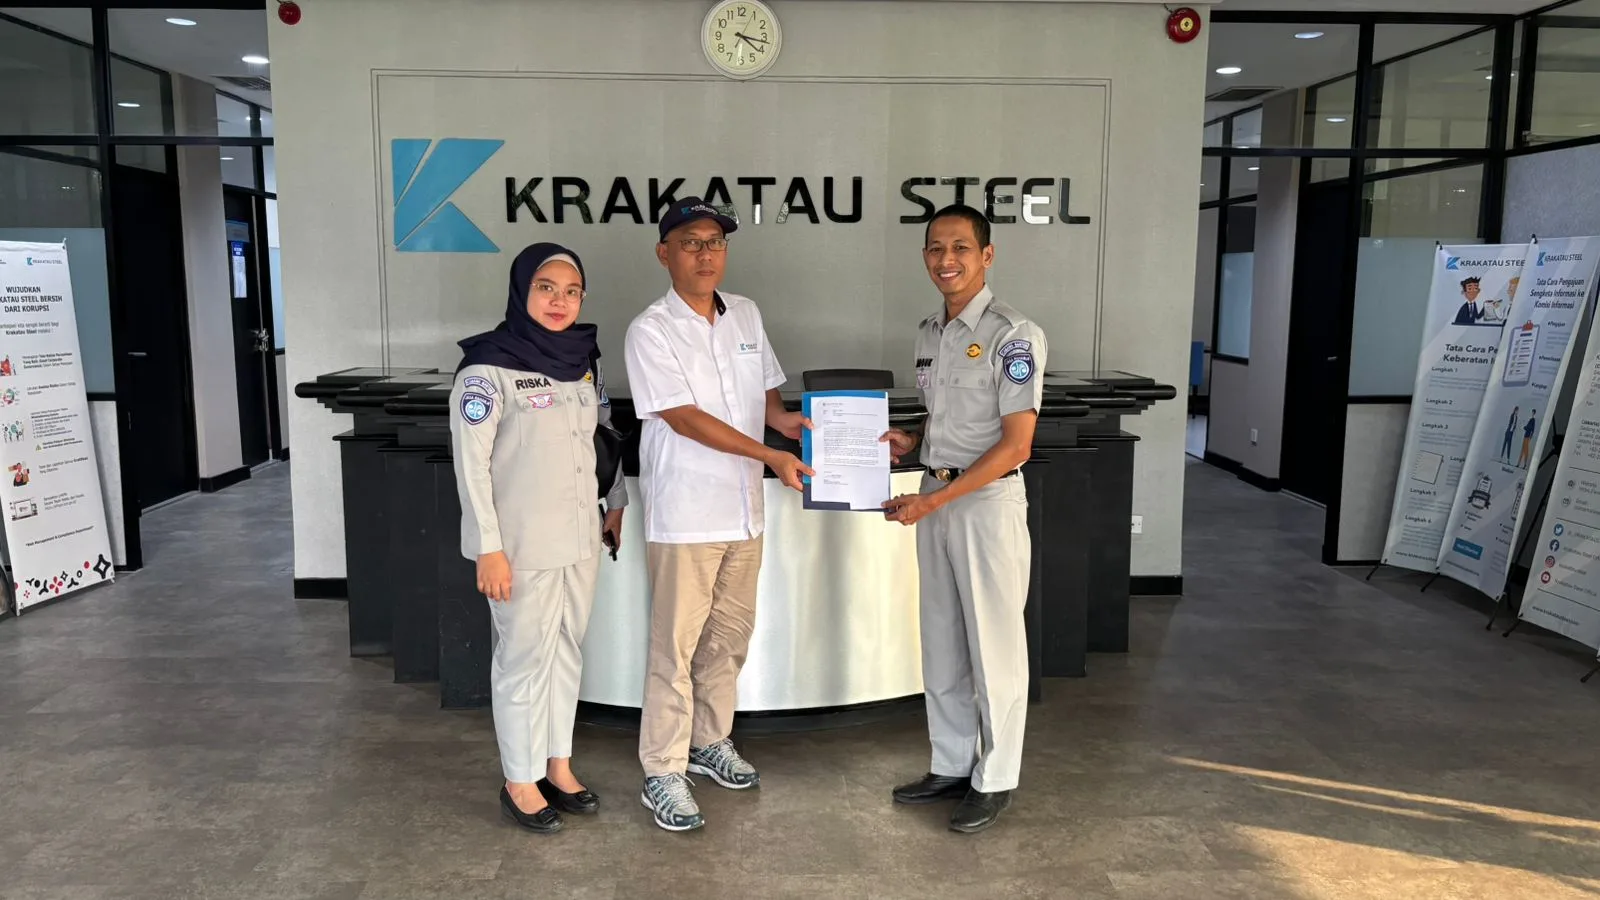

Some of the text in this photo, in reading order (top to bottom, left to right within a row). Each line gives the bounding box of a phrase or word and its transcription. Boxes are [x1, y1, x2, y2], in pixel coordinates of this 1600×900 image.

[726, 10, 734, 20] 11
[737, 7, 746, 16] 12
[753, 11, 756, 20] 1
[718, 18, 727, 28] 10
[760, 20, 766, 29] 2
[715, 31, 722, 40] 9
[761, 32, 767, 42] 3
[718, 44, 724, 53] 8
[759, 45, 764, 54] 4
[727, 52, 733, 62] 7
[738, 56, 744, 65] 6
[750, 53, 756, 62] 5
[505, 177, 1091, 224] KRAKATAU STEEL
[1559, 278, 1584, 287] Pengajuan
[1530, 289, 1553, 299] Sengketa
[1554, 289, 1576, 297] Informasi
[1466, 345, 1486, 353] Cara
[1443, 354, 1488, 364] Keberatan
[515, 378, 552, 390] RISKA
